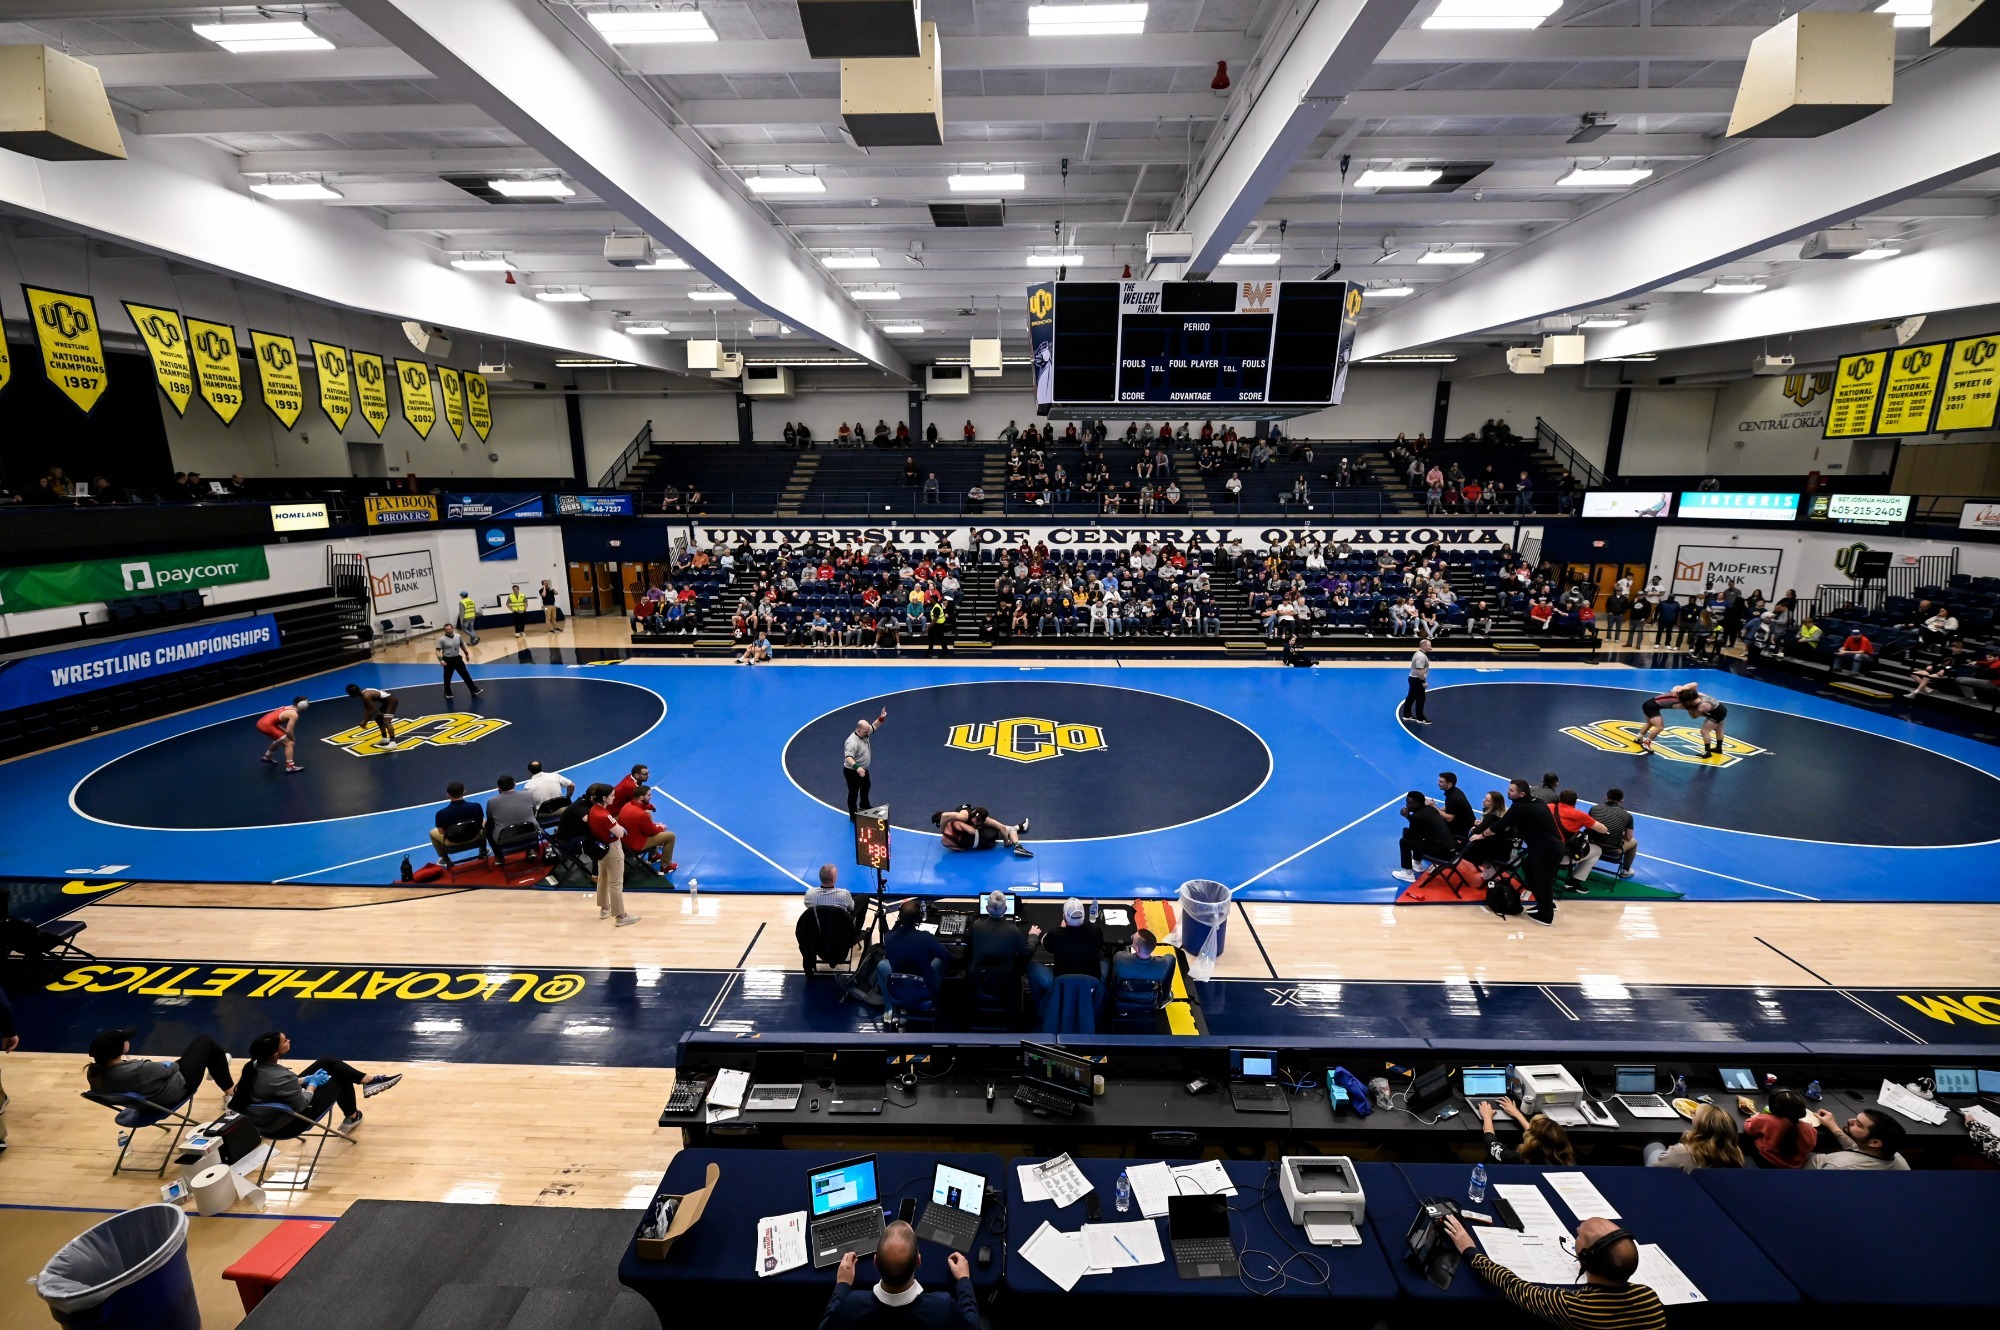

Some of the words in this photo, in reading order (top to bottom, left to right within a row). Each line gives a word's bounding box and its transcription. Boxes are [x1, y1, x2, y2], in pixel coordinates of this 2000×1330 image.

[1124, 283, 1136, 292] THE
[1123, 292, 1160, 304] WEILERT
[1029, 289, 1052, 320] UCO
[1137, 304, 1160, 314] FAMILY
[39, 300, 91, 340] UCO
[140, 314, 182, 350] UCO
[1183, 323, 1210, 331] PERIOD
[54, 341, 90, 350] WRESTLING
[196, 329, 231, 362] UCO
[52, 352, 98, 364] NATIONAL
[260, 341, 294, 371] UCO
[1964, 340, 1997, 366] UCO
[50, 360, 104, 374] CHAMPIONS
[160, 360, 190, 372] NATIONAL
[320, 351, 345, 378] UCO
[1122, 360, 1146, 368] FOULS
[1168, 360, 1188, 368] FOUL
[1190, 360, 1218, 368] PLAYER
[1242, 360, 1266, 368] FOULS
[1902, 350, 1932, 374] UCO
[358, 360, 381, 385] UCO
[1847, 358, 1875, 381] UCO
[64, 376, 98, 390] 1987
[203, 372, 238, 382] NATIONAL
[402, 367, 427, 391] UCO
[170, 381, 190, 394] 1989
[268, 382, 298, 390] NATIONAL
[1892, 382, 1930, 392] NATIONAL
[1954, 380, 1981, 389] SWEET
[1982, 378, 1992, 386] 16
[212, 392, 238, 404] 1992
[326, 388, 349, 396] NATIONAL
[1122, 392, 1146, 400] SCORE
[1170, 392, 1212, 400] ADVANTAGE
[1239, 392, 1262, 400] SCORE
[1839, 388, 1872, 397] NATIONAL
[1888, 390, 1932, 399] TOURNAMENT
[275, 400, 298, 410] 1993
[1836, 395, 1875, 404] TOURNAMENT
[332, 404, 348, 415] 1994
[368, 411, 385, 420] 1995
[414, 414, 432, 423] 2002
[1738, 420, 1790, 432] CENTRAL
[366, 496, 435, 512] TEXTBOOK
[1701, 495, 1793, 507] INTEGRIS
[560, 503, 580, 512] SIGNS
[1832, 506, 1902, 516] 405-215-2405
[383, 512, 426, 522] BROKERS
[703, 529, 958, 544] UNIVERSITY
[977, 529, 1030, 544] OF
[1048, 528, 1242, 544] CENTRAL
[1260, 528, 1503, 544] OKLAHOMA
[392, 567, 432, 581] MIDFIRST
[1708, 562, 1778, 574] MIDFIRST
[156, 563, 236, 586] paycom
[1706, 573, 1745, 584] BANK
[394, 582, 419, 594] BANK
[51, 651, 151, 687] WRESTLING
[155, 627, 270, 665] CHAMPIONSHIPS
[944, 716, 1108, 764] UCO
[878, 818, 885, 831] 5
[46, 965, 586, 1003] @UCOATHLETICS
